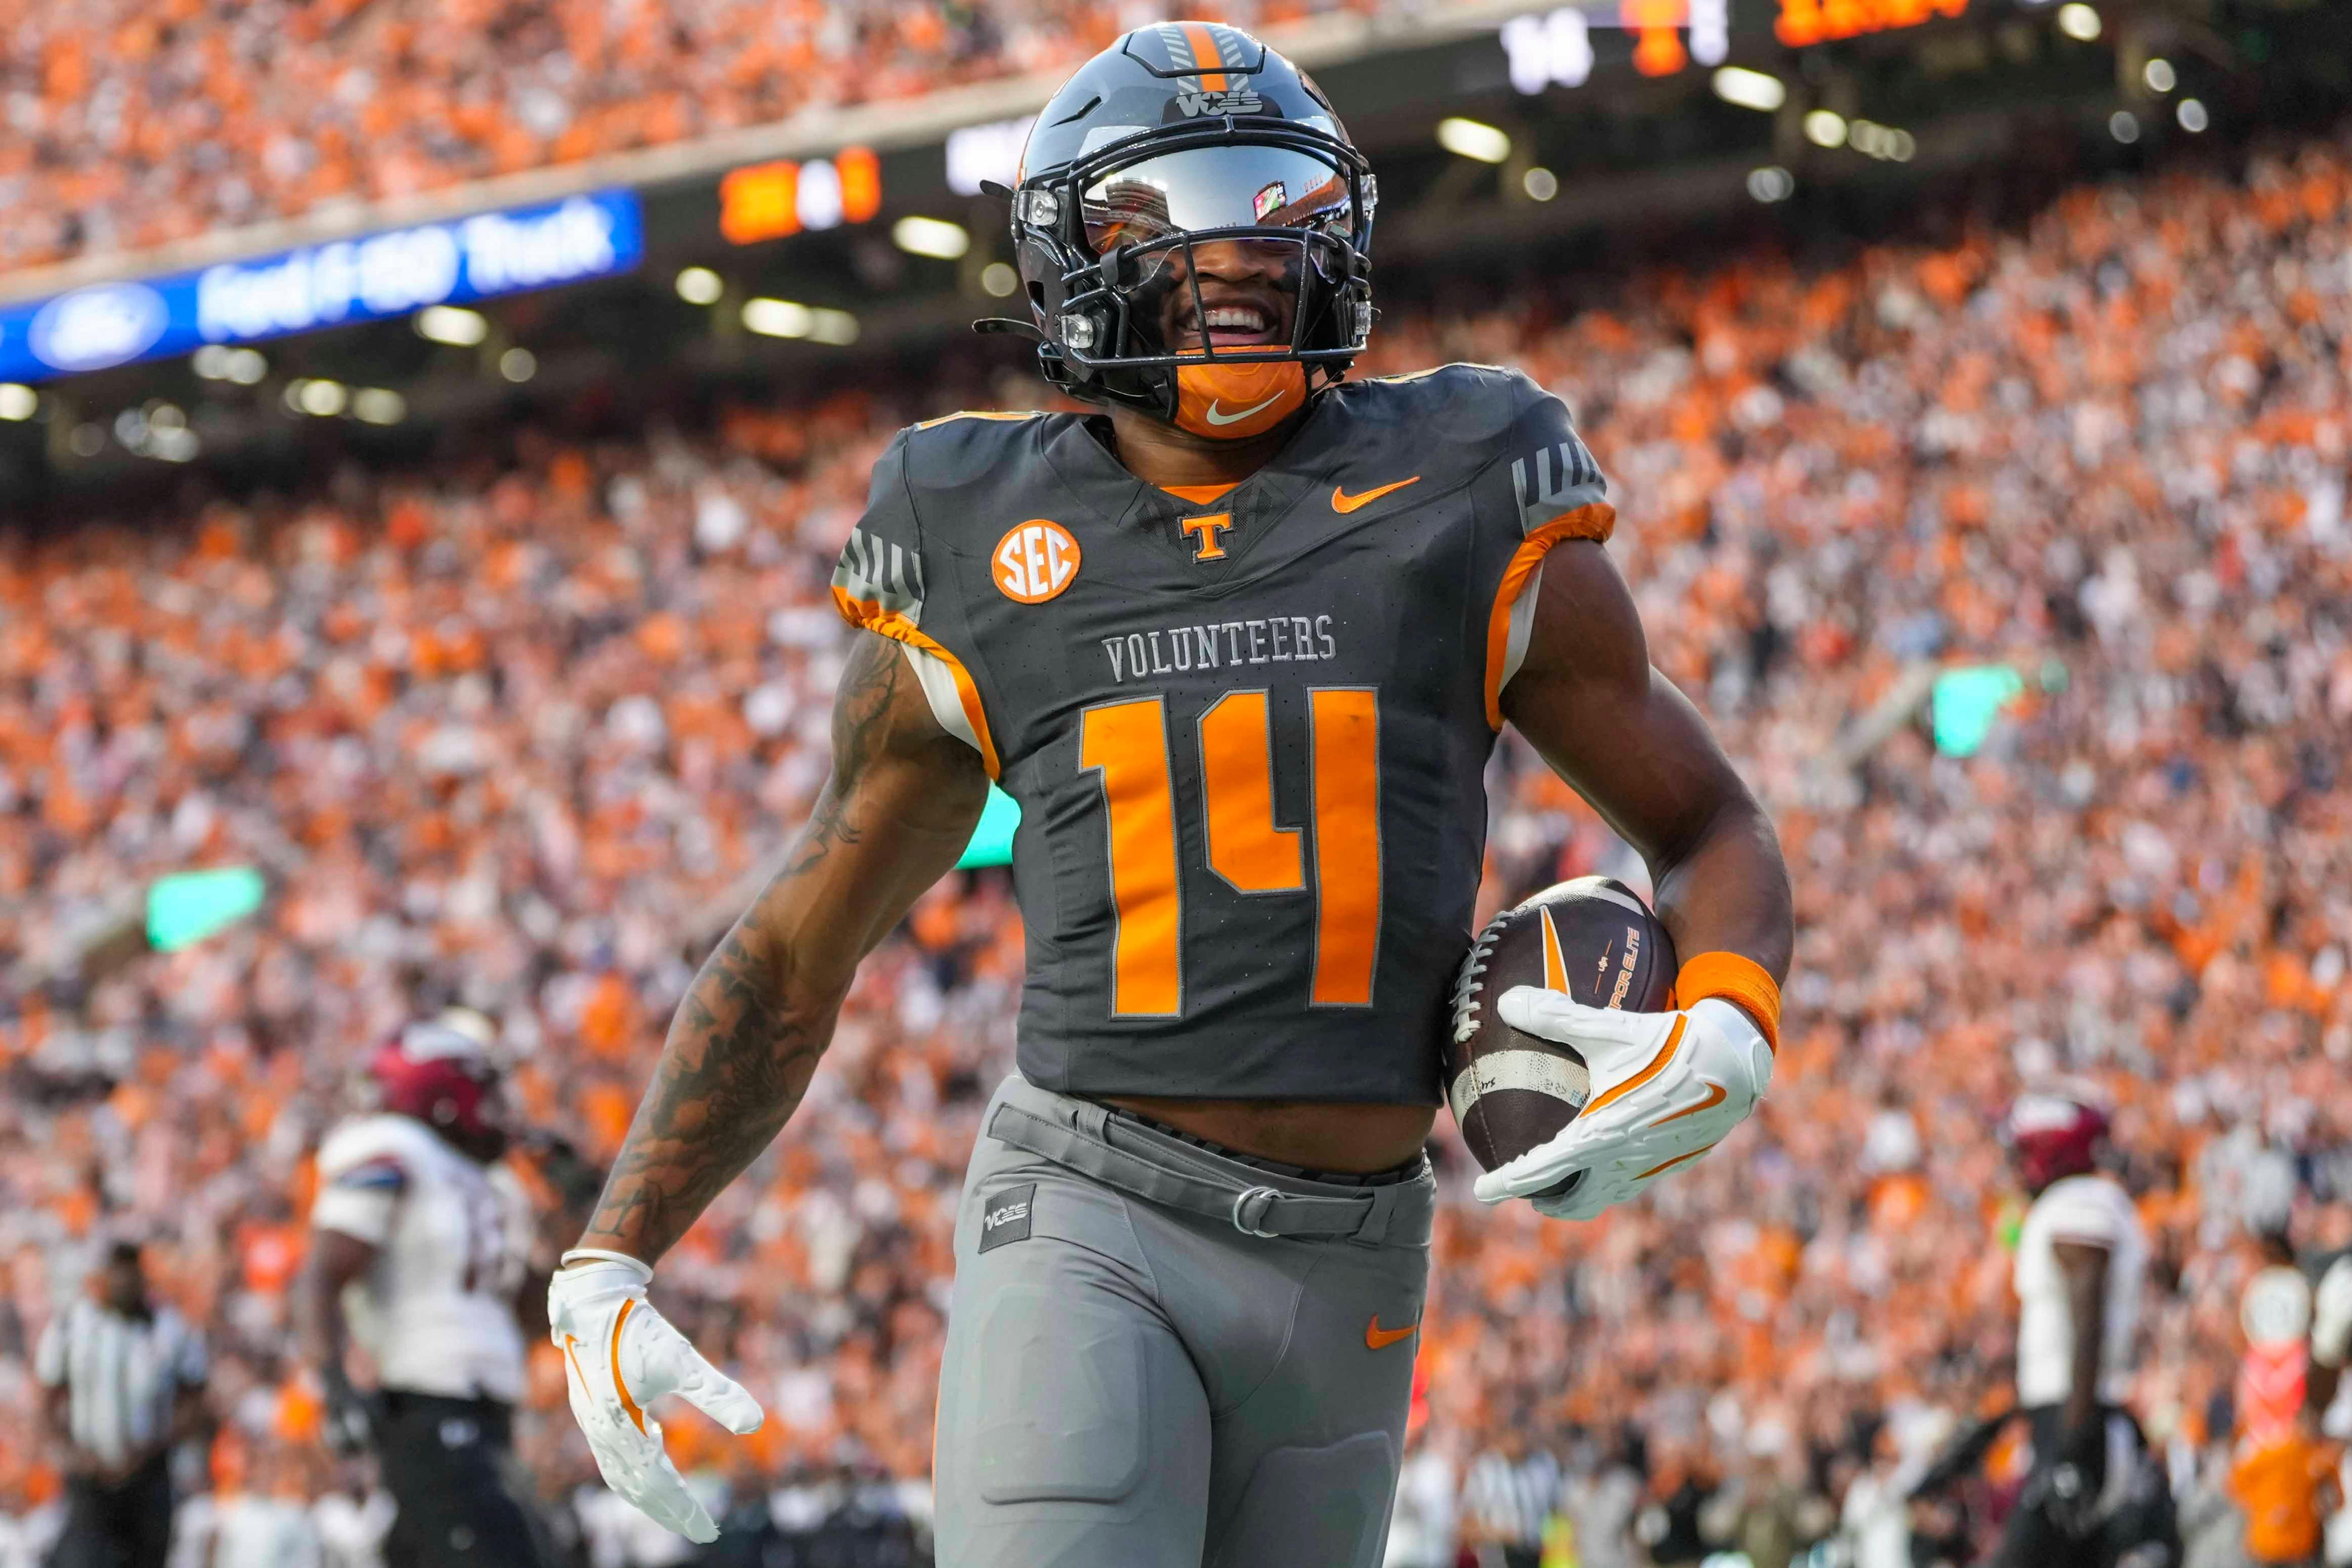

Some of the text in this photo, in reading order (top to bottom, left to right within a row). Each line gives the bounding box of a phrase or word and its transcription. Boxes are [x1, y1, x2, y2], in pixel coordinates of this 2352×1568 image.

[999, 526, 1073, 597] SEC
[1178, 511, 1234, 564] T
[1101, 615, 1336, 682] VOLUNTEERS
[1078, 686, 1383, 1018] 14
[1623, 927, 1640, 972] ELITE
